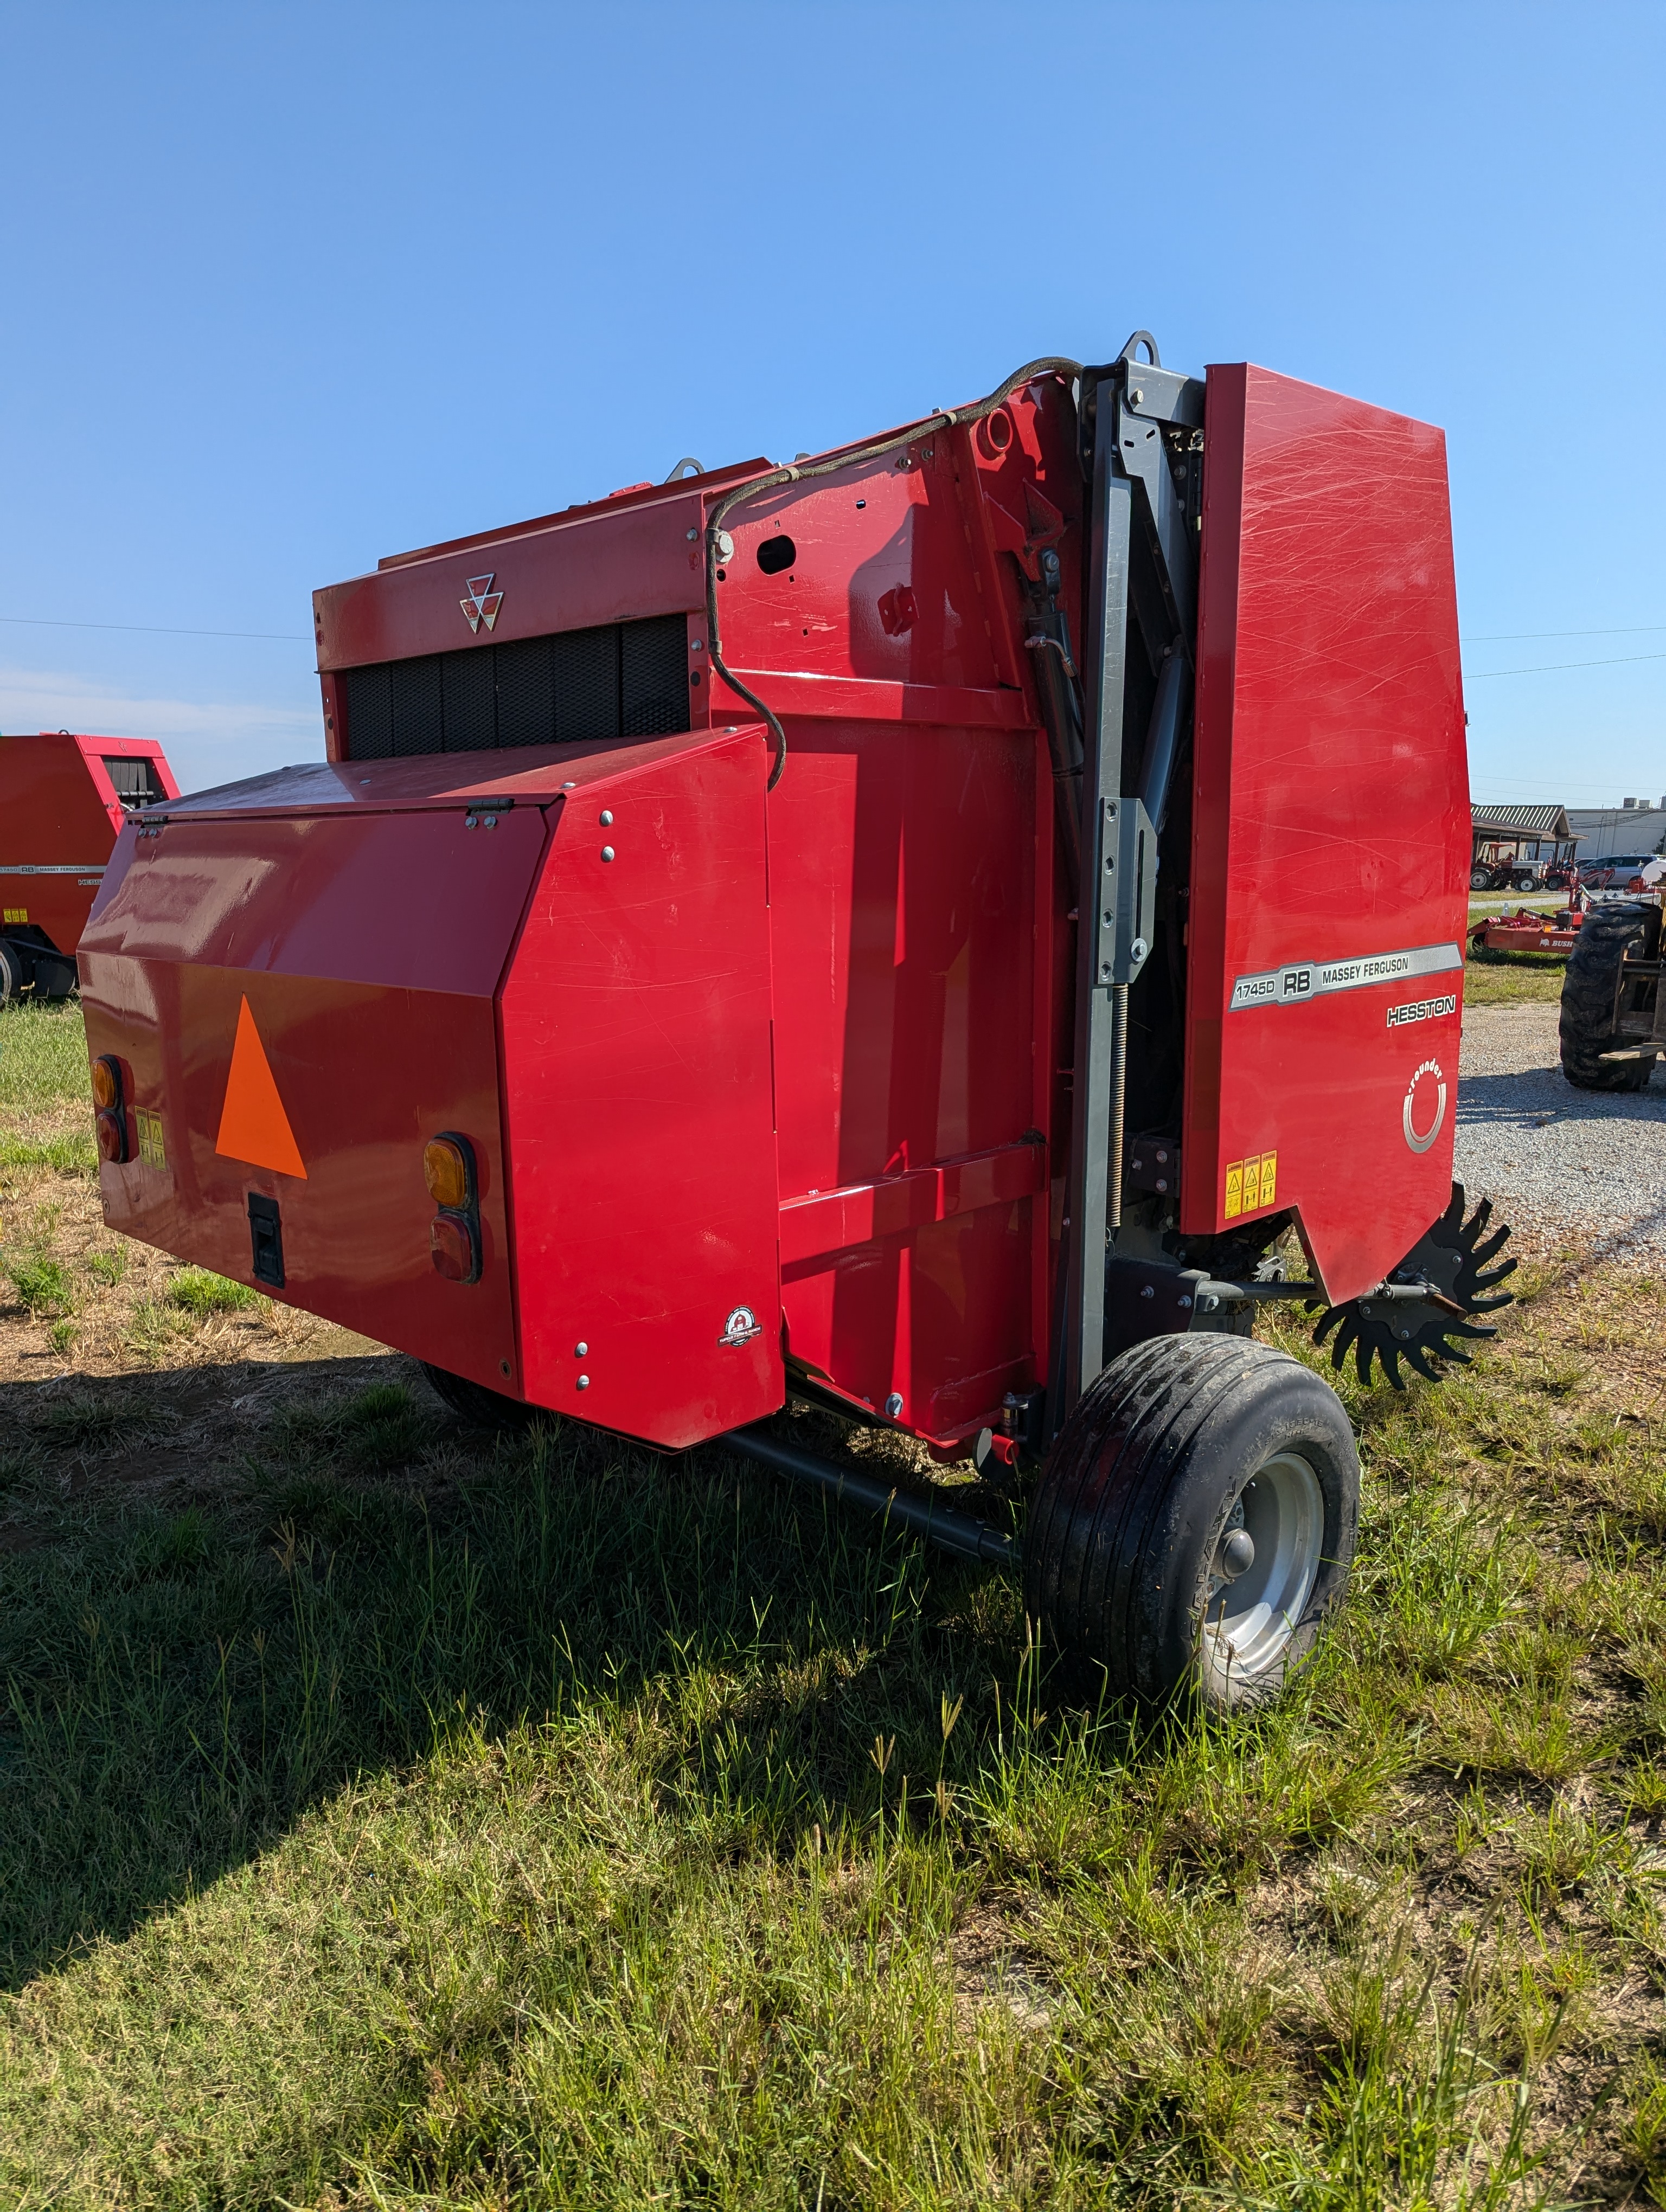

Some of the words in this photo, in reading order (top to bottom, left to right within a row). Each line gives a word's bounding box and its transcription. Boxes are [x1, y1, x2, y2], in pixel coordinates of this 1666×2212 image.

[1236, 979, 1275, 1000] 1745D
[1283, 969, 1311, 998] RB
[1322, 964, 1361, 986] MASSEY
[1363, 956, 1409, 978] FERGUSON
[1387, 994, 1456, 1027] HESSTON
[1410, 1058, 1443, 1089] rounder
[1190, 1478, 1236, 1638] GALAXY
